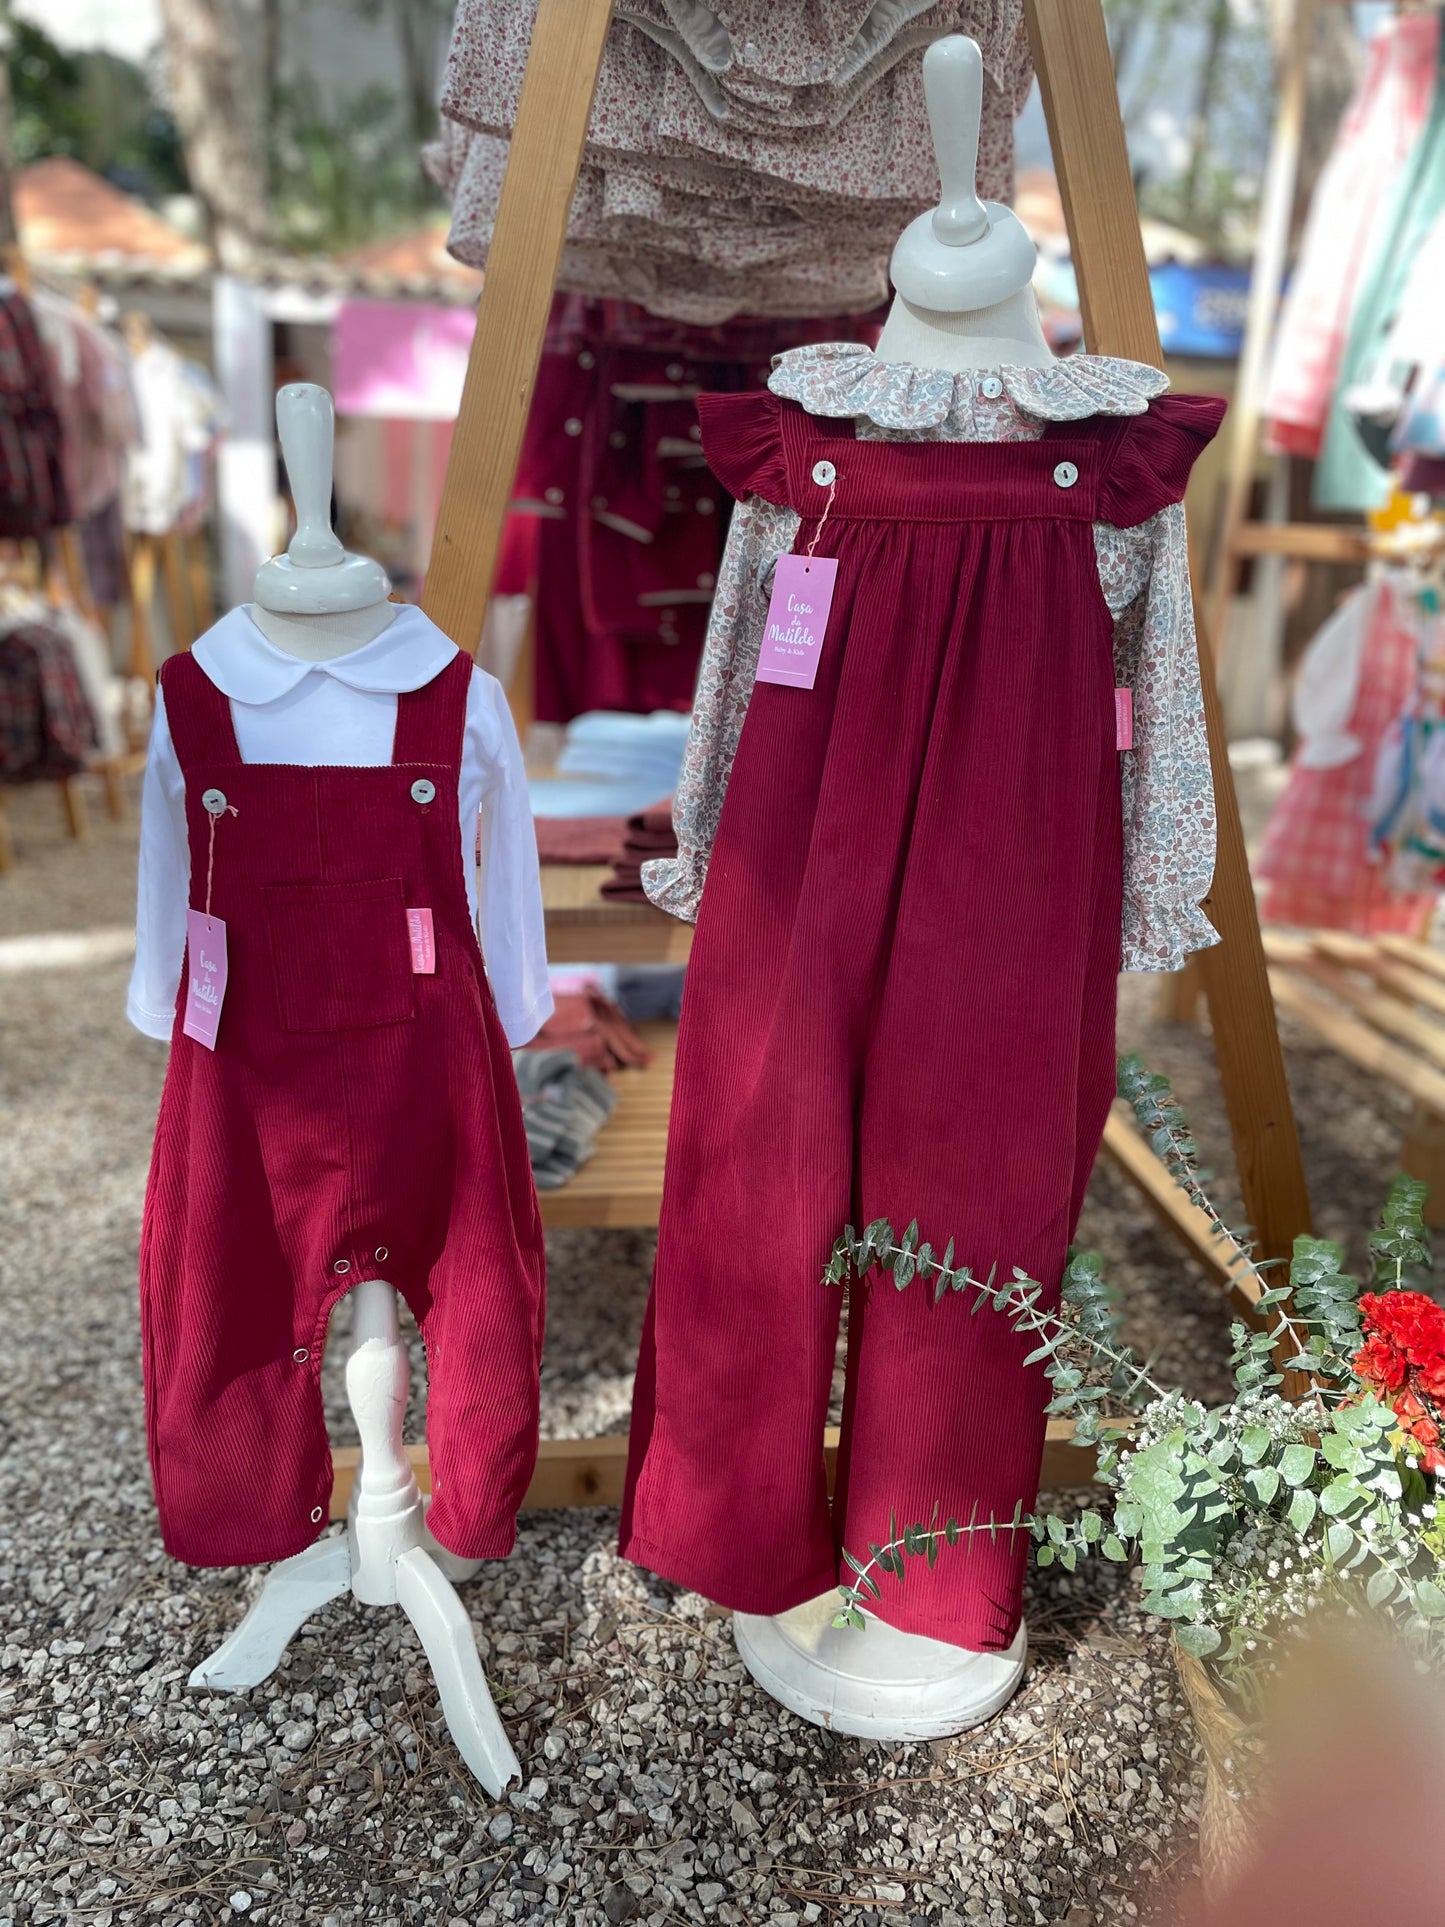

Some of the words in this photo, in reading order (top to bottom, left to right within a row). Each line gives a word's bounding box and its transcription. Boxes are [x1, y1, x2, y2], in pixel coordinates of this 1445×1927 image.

[787, 593, 814, 615] Casa
[791, 615, 801, 626] da
[767, 624, 816, 646] Matilde
[192, 978, 218, 1006] Matilde
